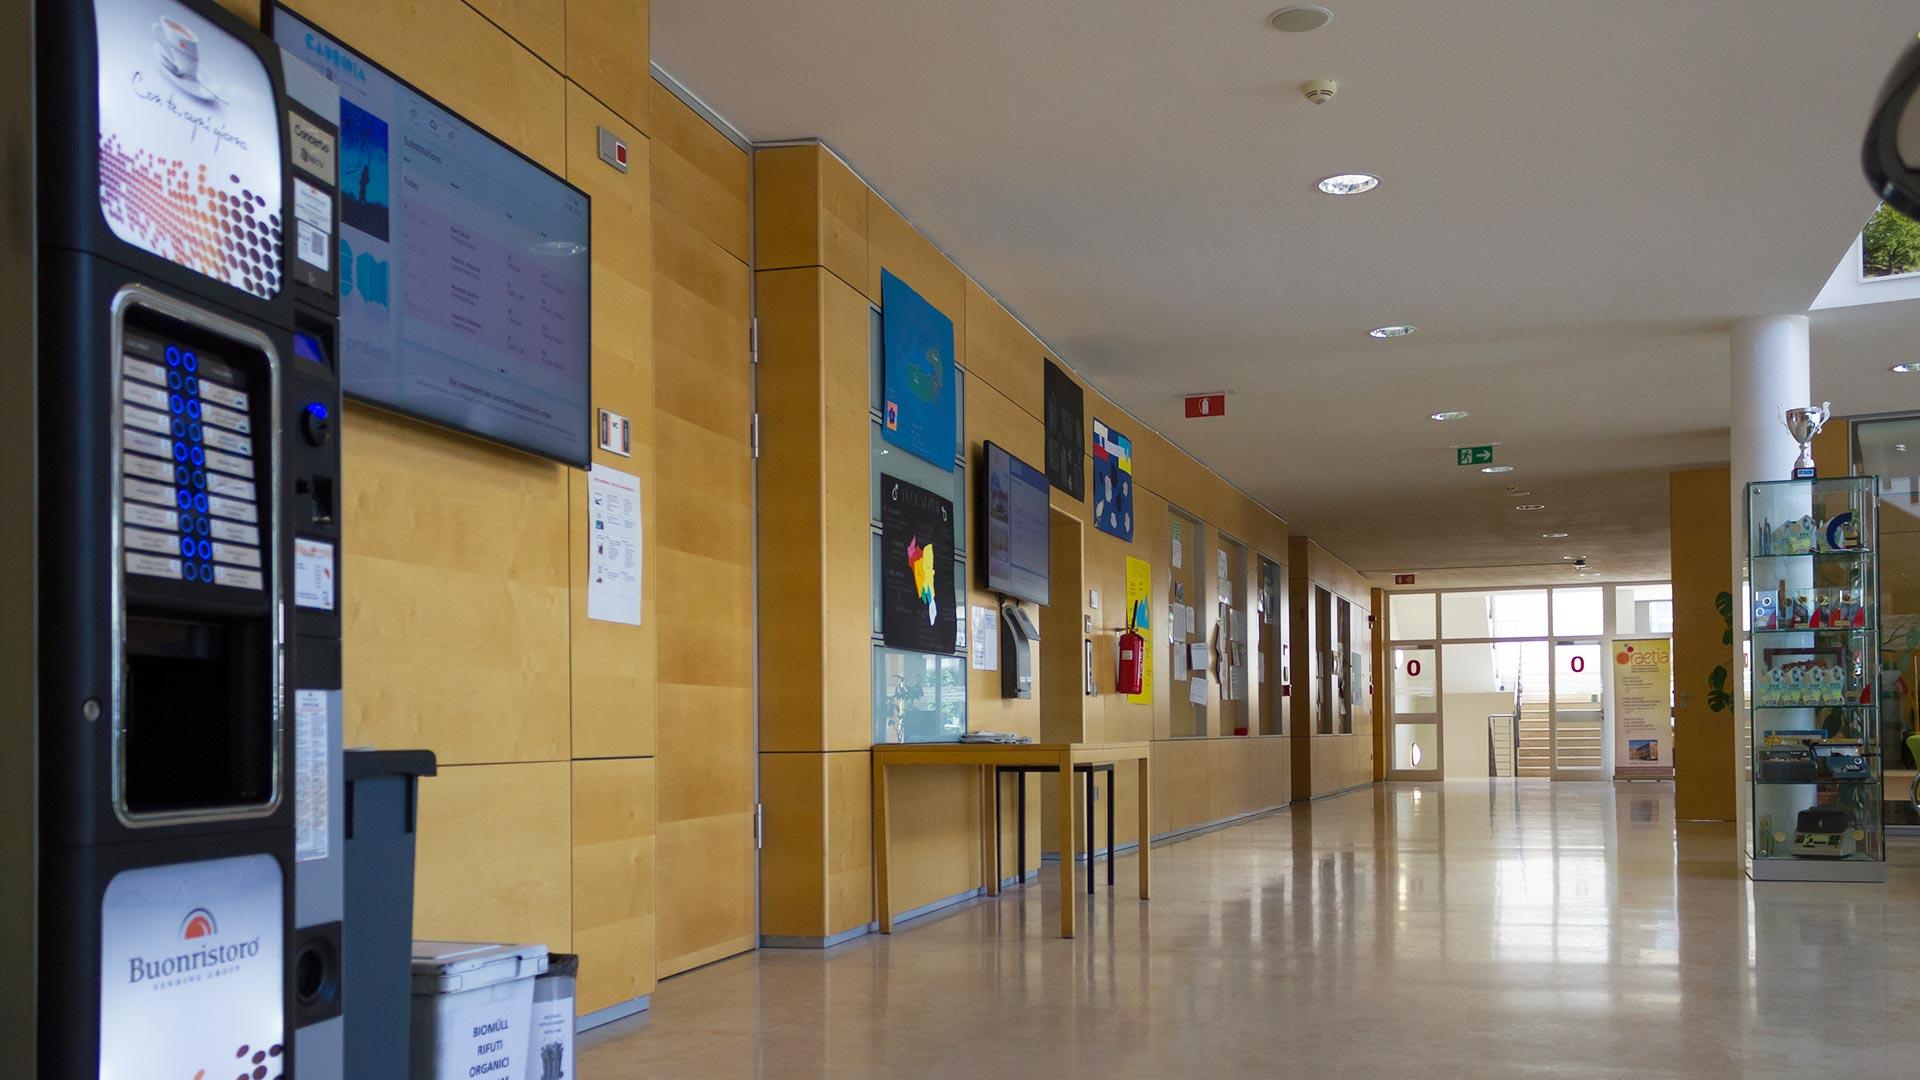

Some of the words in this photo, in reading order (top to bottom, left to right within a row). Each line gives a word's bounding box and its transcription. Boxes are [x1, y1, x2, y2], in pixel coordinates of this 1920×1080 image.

[1631, 647, 1669, 665] raetia
[128, 938, 260, 985] Buonristoro
[472, 1018, 509, 1038] BIOMÜLL
[469, 1057, 509, 1078] ORGANICI
